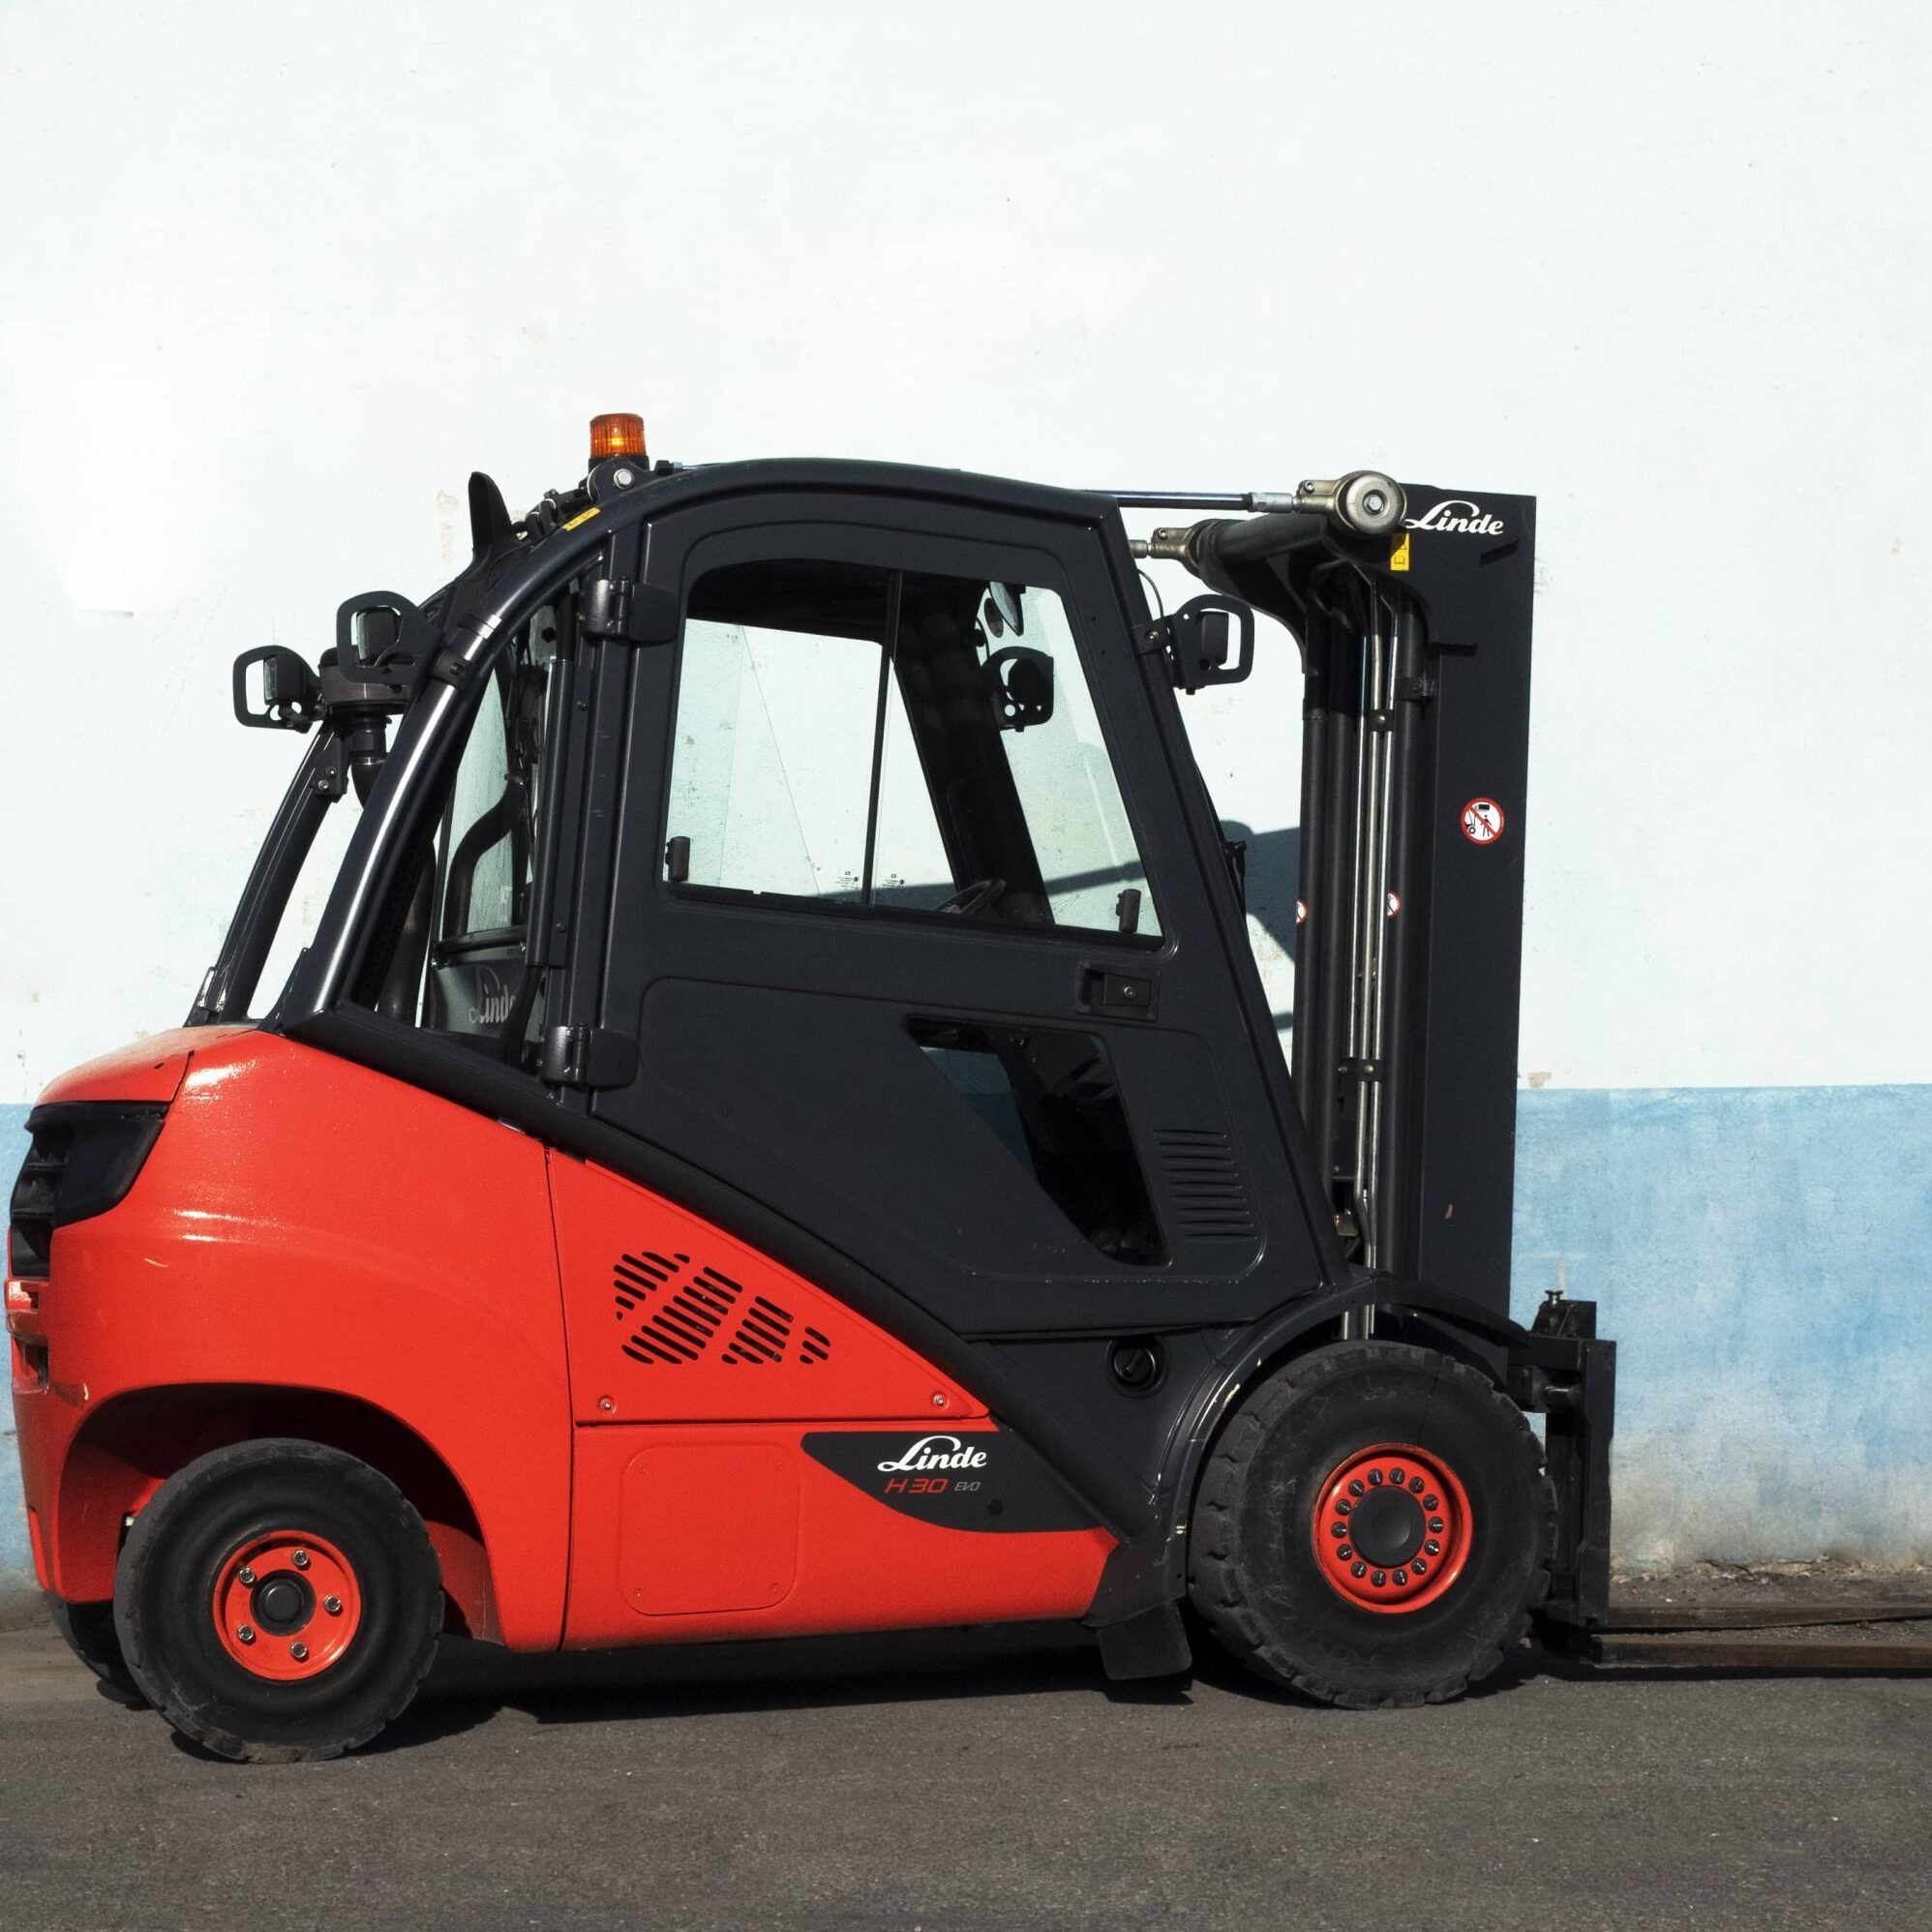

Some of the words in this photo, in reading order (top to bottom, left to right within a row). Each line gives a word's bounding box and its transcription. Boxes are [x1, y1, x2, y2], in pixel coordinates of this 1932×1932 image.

[1404, 499, 1504, 535] Linde
[877, 1434, 987, 1472] Linde
[953, 1481, 981, 1492] EVO
